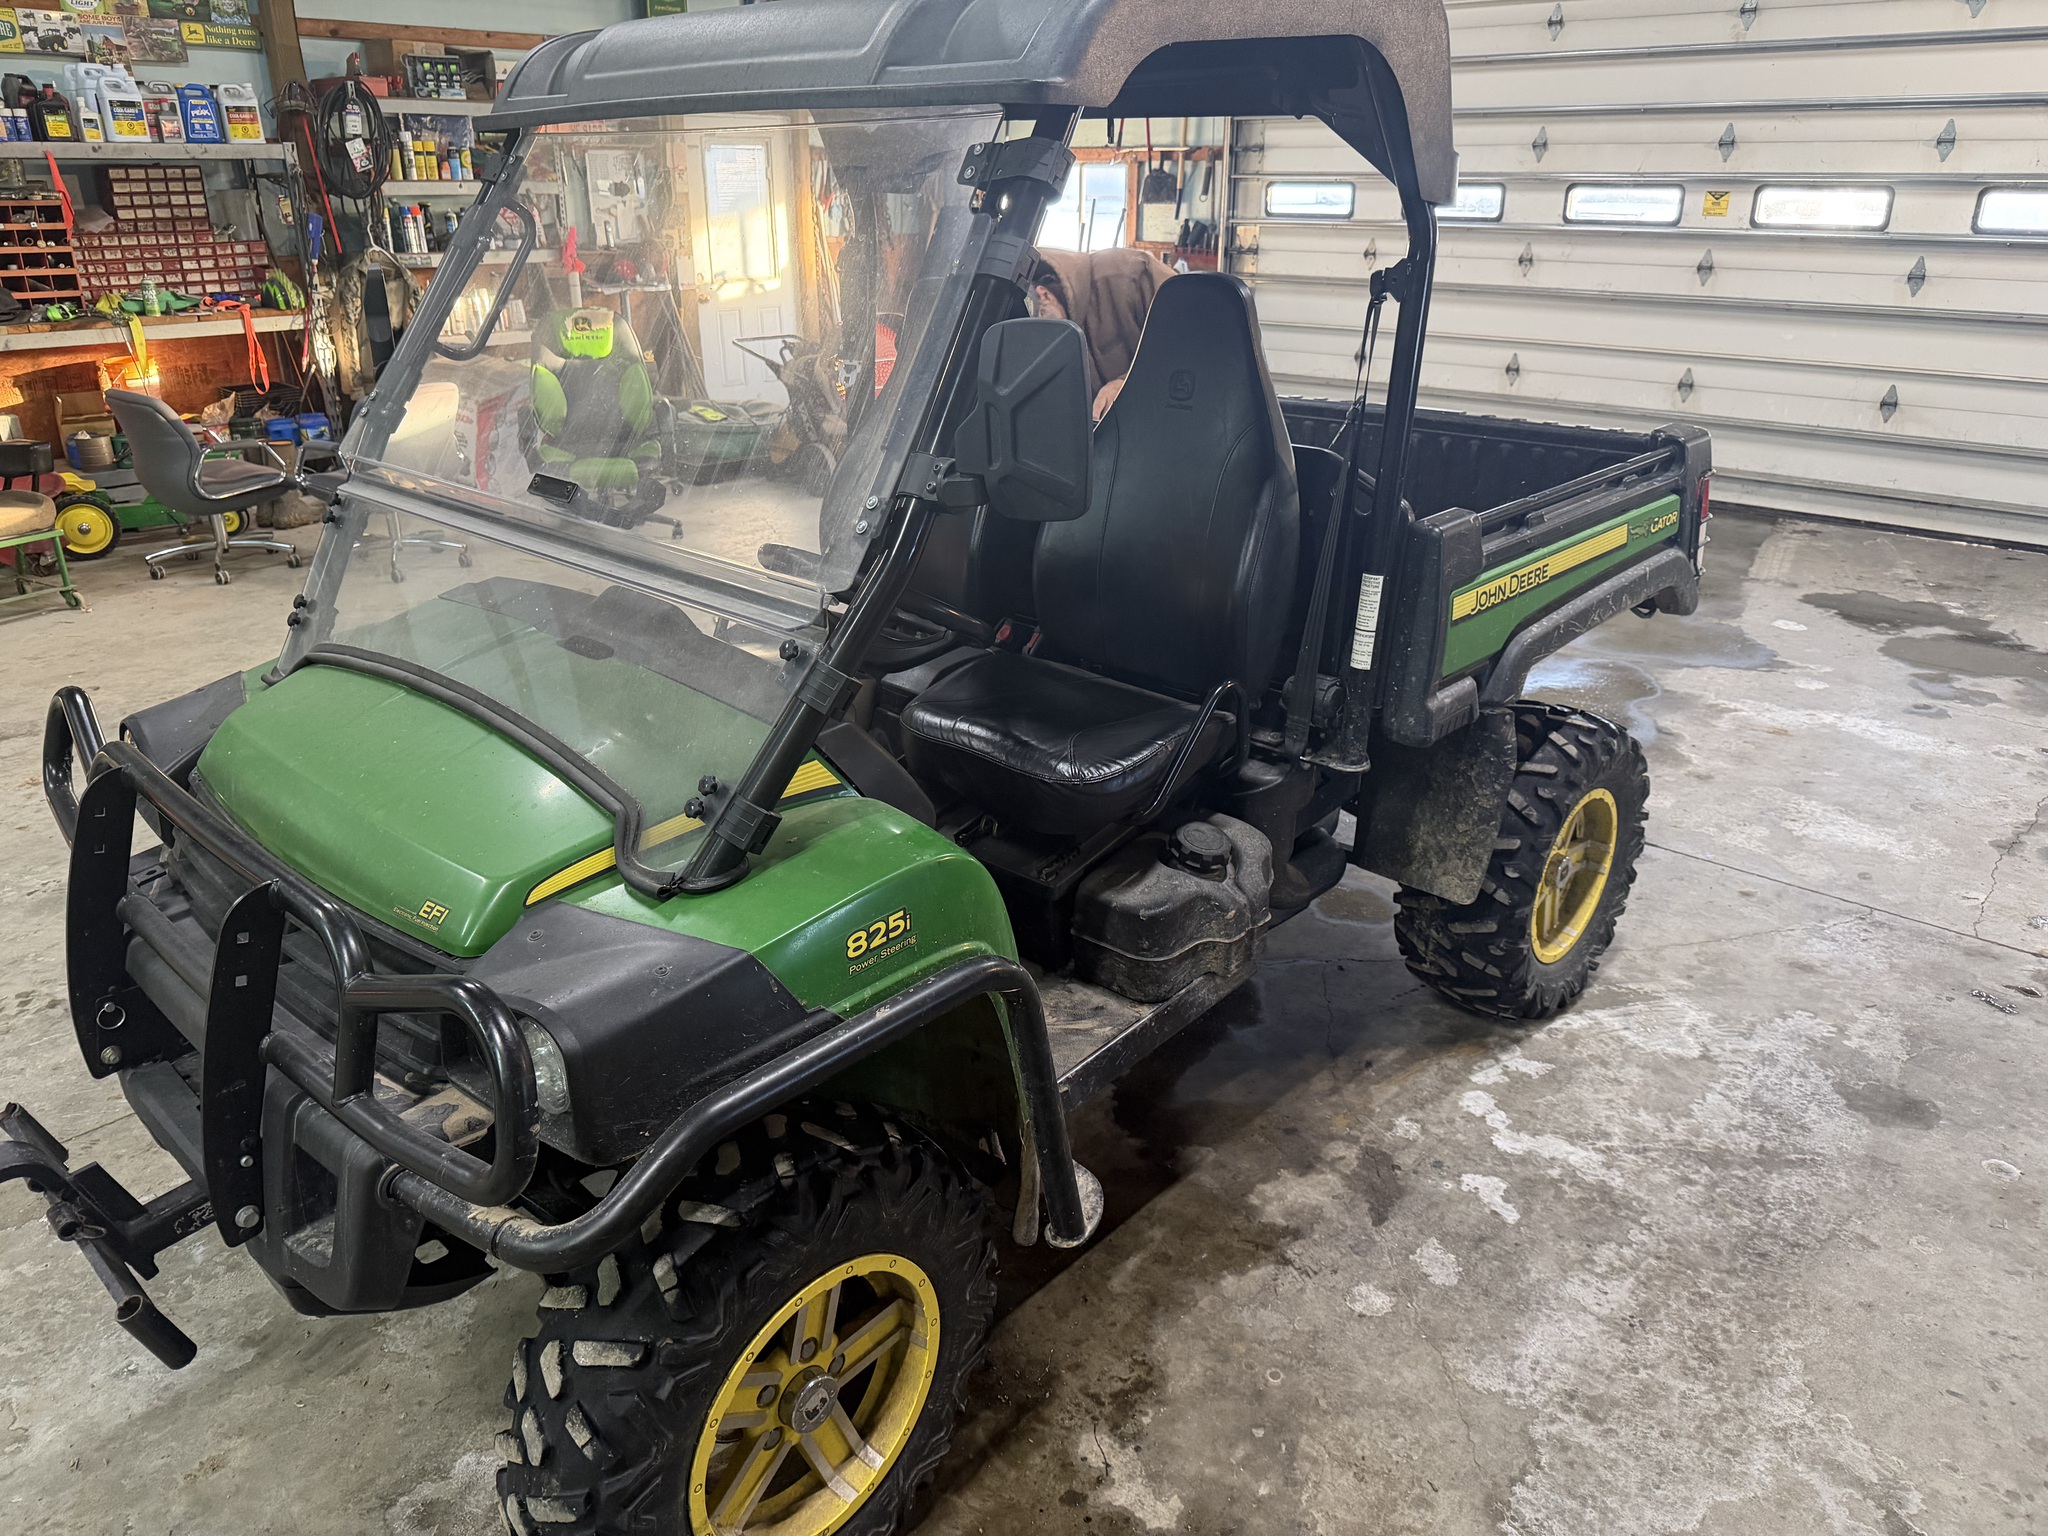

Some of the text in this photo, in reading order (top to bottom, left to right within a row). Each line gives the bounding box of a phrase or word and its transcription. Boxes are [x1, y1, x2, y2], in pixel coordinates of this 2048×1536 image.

[205, 24, 237, 35] Nothing
[207, 36, 222, 44] like
[232, 37, 256, 46] Deere
[190, 108, 211, 117] PEAK
[1650, 510, 1678, 533] GATOR
[1471, 563, 1550, 614] JOHN DEERE
[418, 900, 450, 925] EFI
[846, 909, 911, 959] 825i
[849, 934, 917, 976] Power Steering
